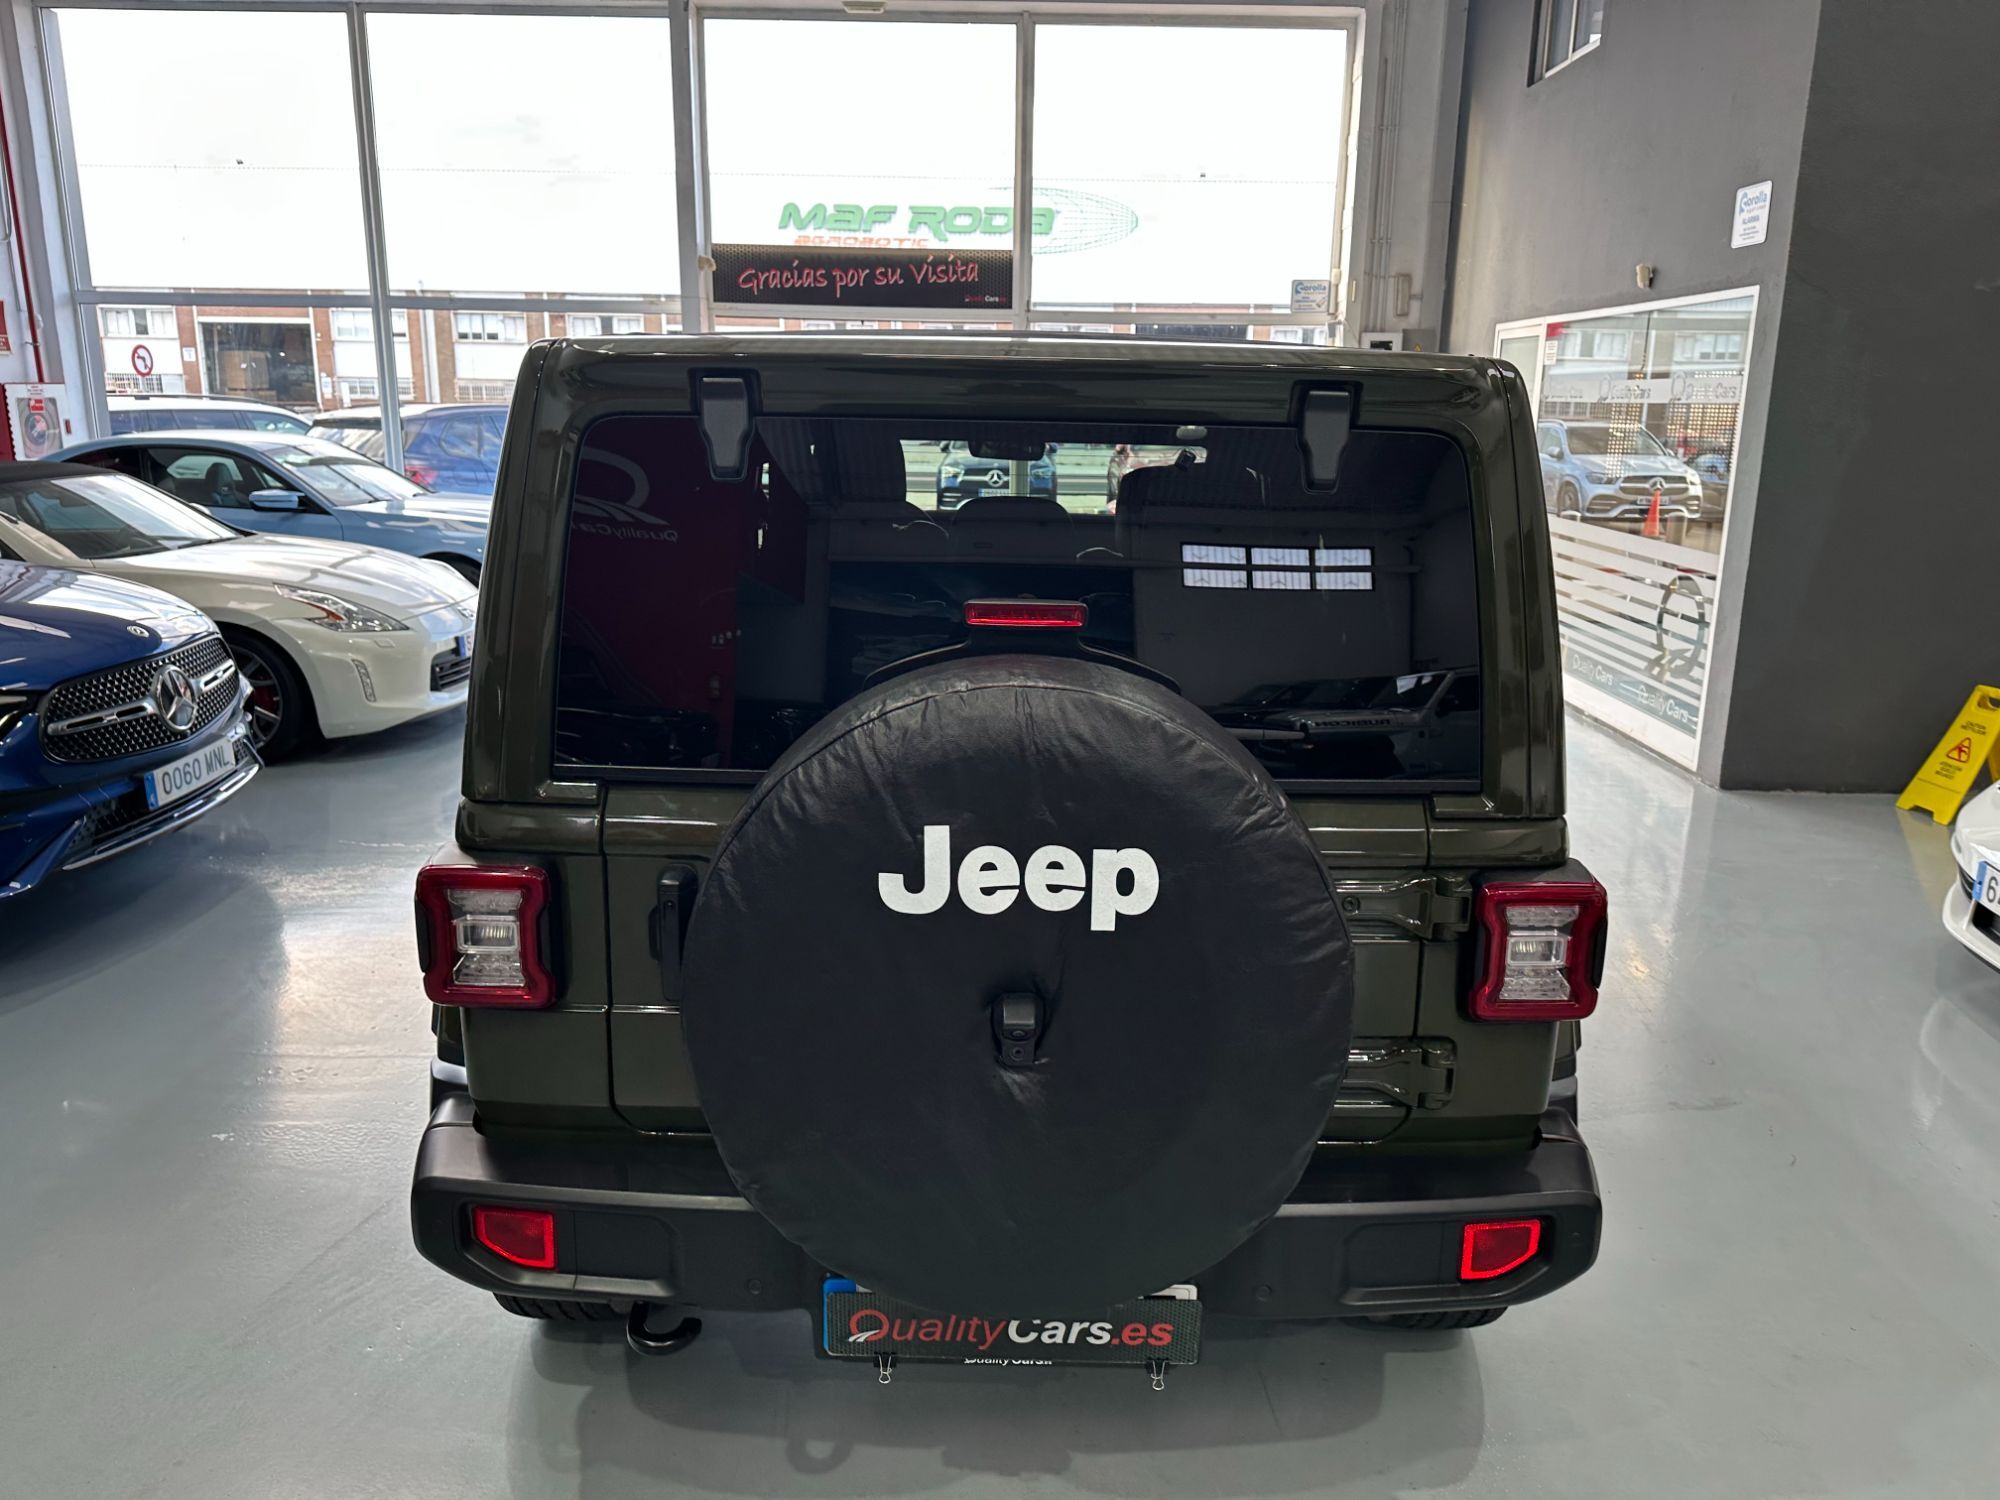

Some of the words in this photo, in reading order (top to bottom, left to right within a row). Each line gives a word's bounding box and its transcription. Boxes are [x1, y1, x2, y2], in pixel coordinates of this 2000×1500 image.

[737, 258, 828, 295] Gracias
[832, 267, 870, 298] por
[873, 266, 905, 286] su
[162, 758, 202, 794] 0060
[204, 745, 230, 775] MNL
[878, 825, 1160, 931] Jeep
[848, 1308, 1175, 1350] QualityCars.es
